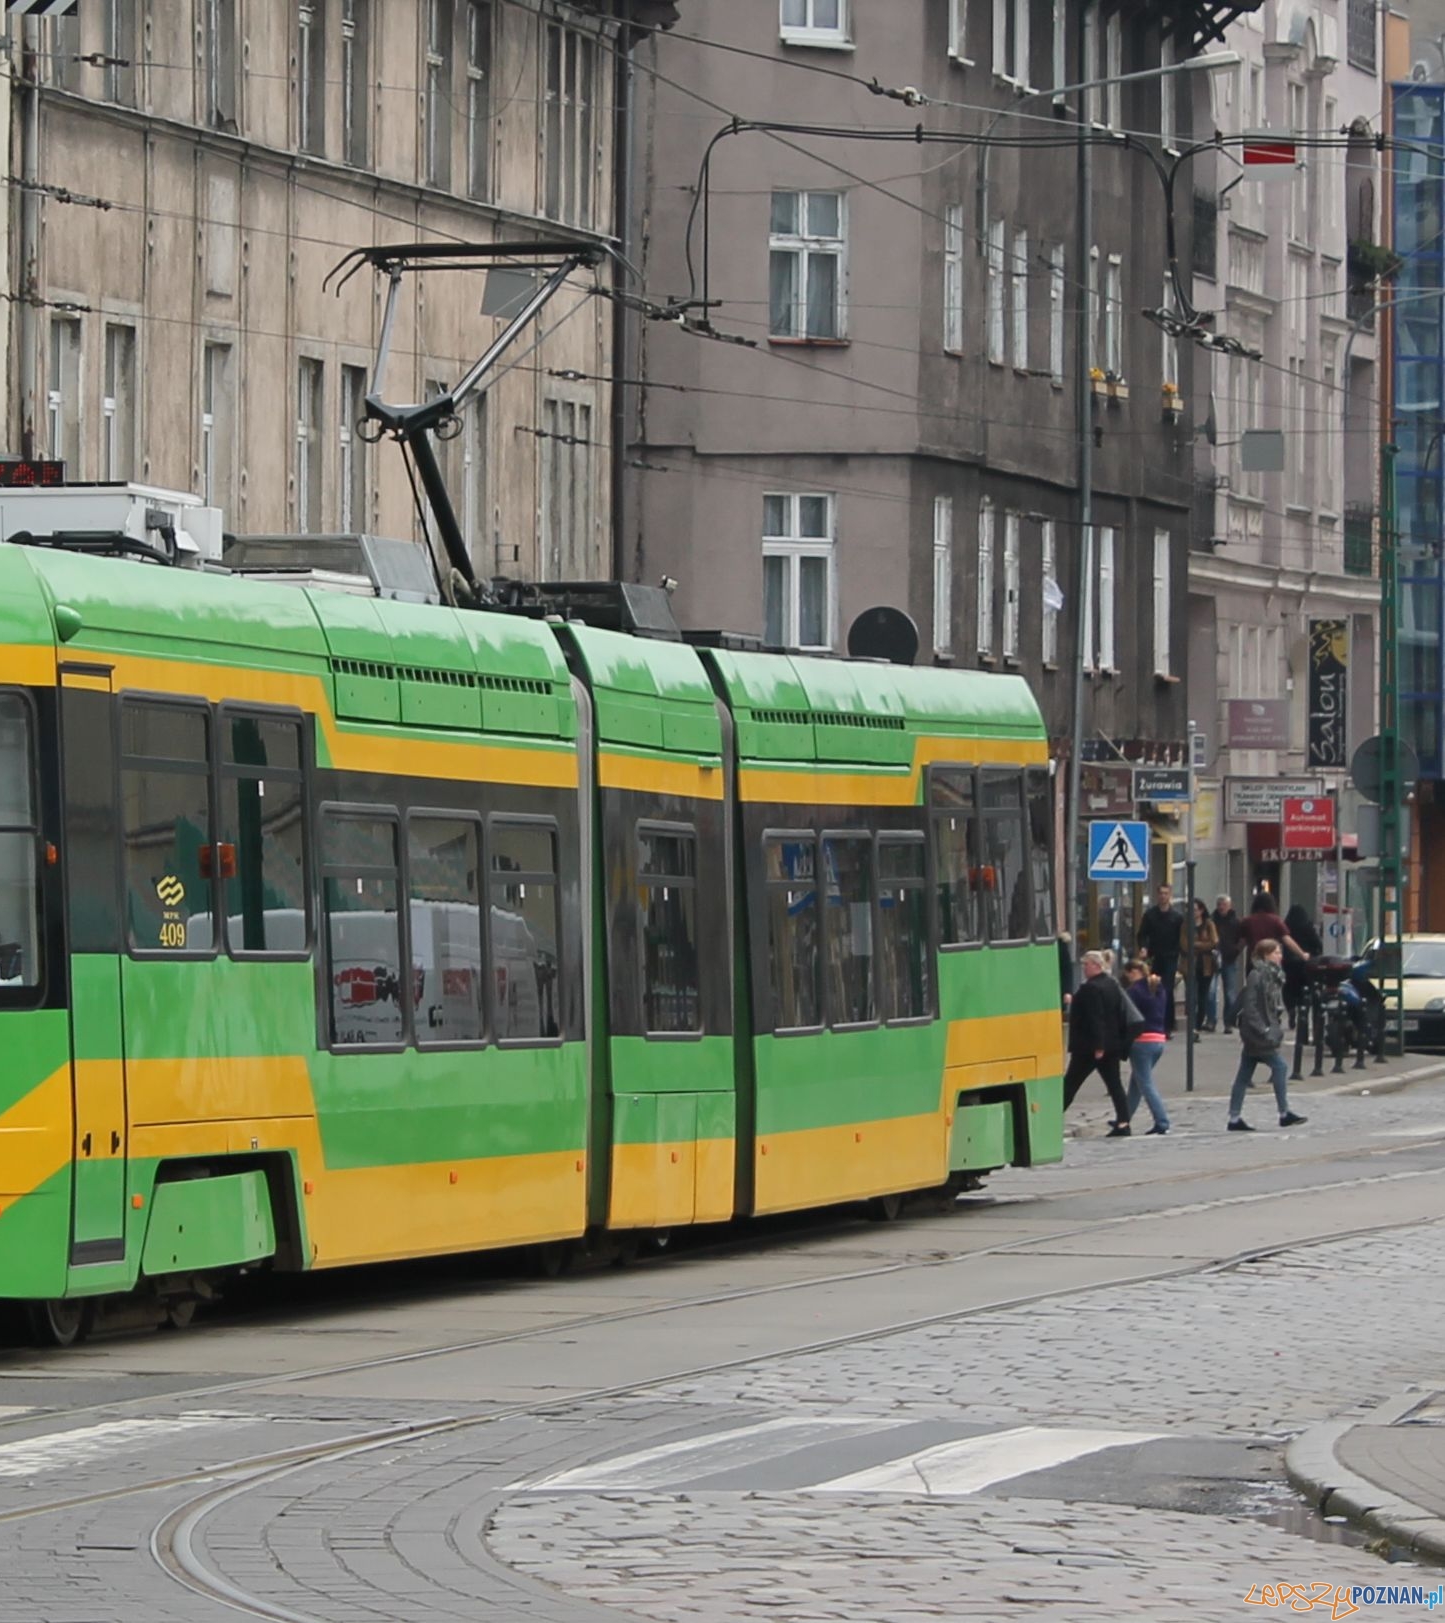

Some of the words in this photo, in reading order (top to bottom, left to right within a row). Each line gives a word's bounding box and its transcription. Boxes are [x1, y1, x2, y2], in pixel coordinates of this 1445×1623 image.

[1310, 672, 1336, 764] Salon
[1138, 777, 1183, 791] Żurawia
[159, 923, 186, 947] 409
